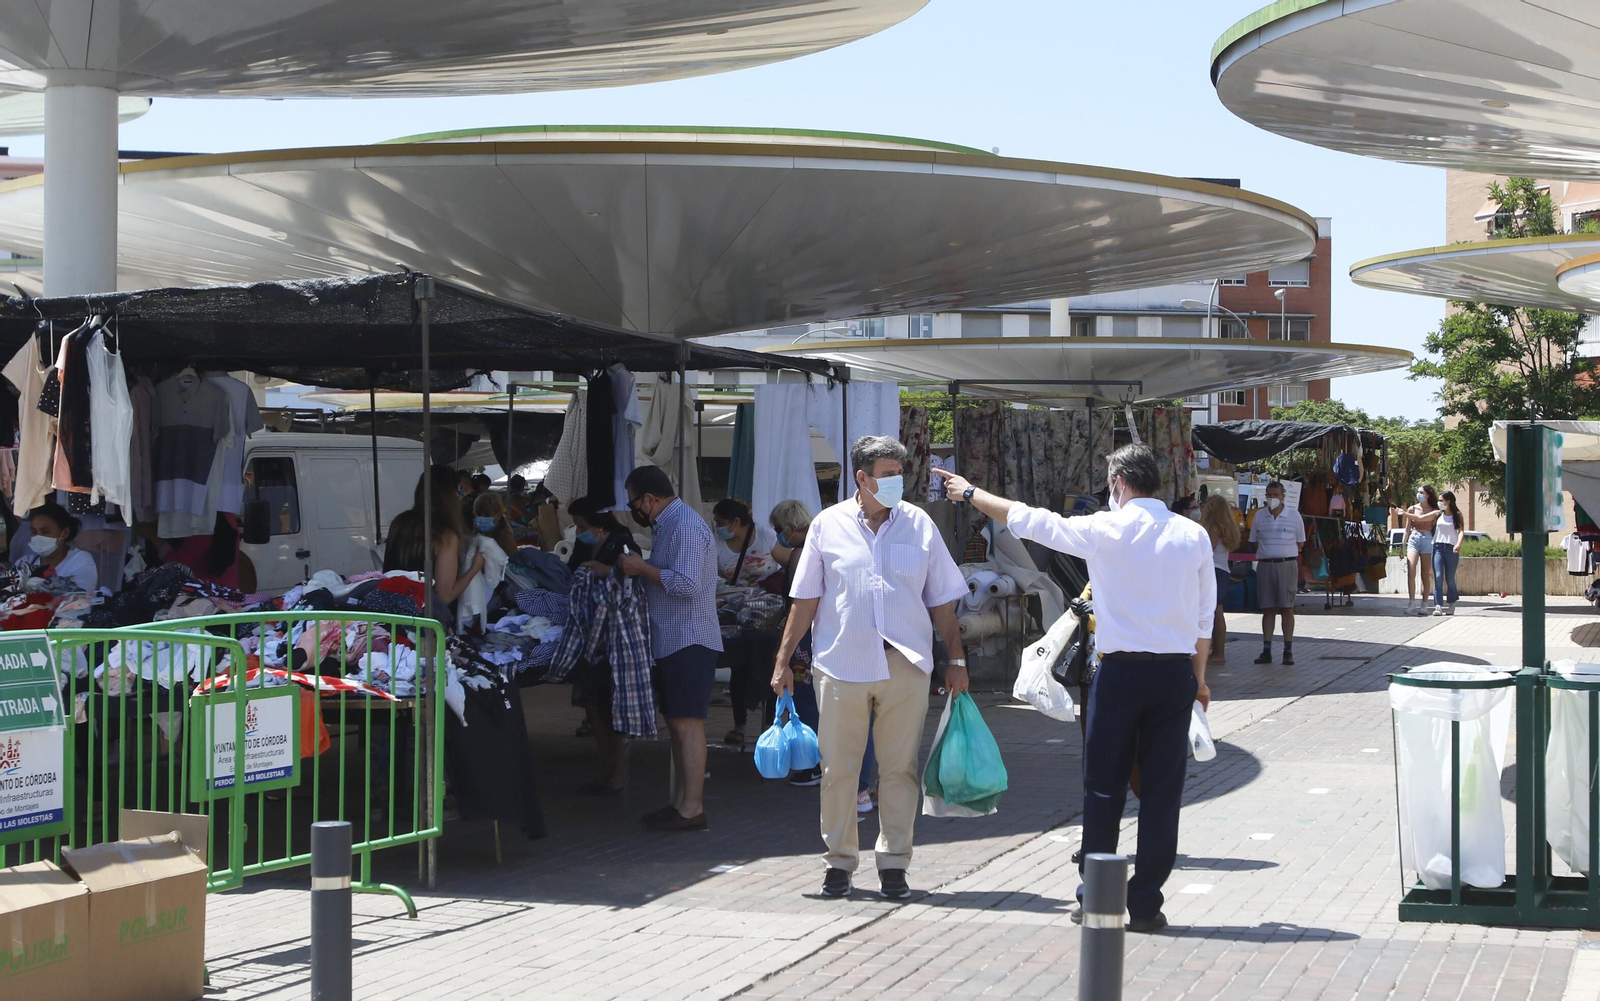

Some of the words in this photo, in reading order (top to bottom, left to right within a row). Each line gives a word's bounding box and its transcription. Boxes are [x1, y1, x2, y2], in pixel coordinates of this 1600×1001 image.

[253, 738, 260, 748] DE
[261, 734, 288, 747] CÓRDOBA
[218, 754, 232, 765] Área
[253, 760, 273, 769] Montajes
[15, 776, 24, 789] DE
[25, 771, 57, 787] CÓRDOBA
[245, 775, 255, 783] LAS
[255, 769, 285, 780] MOLESTIAS
[6, 807, 13, 815] de
[14, 802, 40, 812] Montajes
[3, 819, 17, 829] LAS
[17, 813, 54, 827] MOLESTIAS
[119, 906, 188, 943] POLISUR
